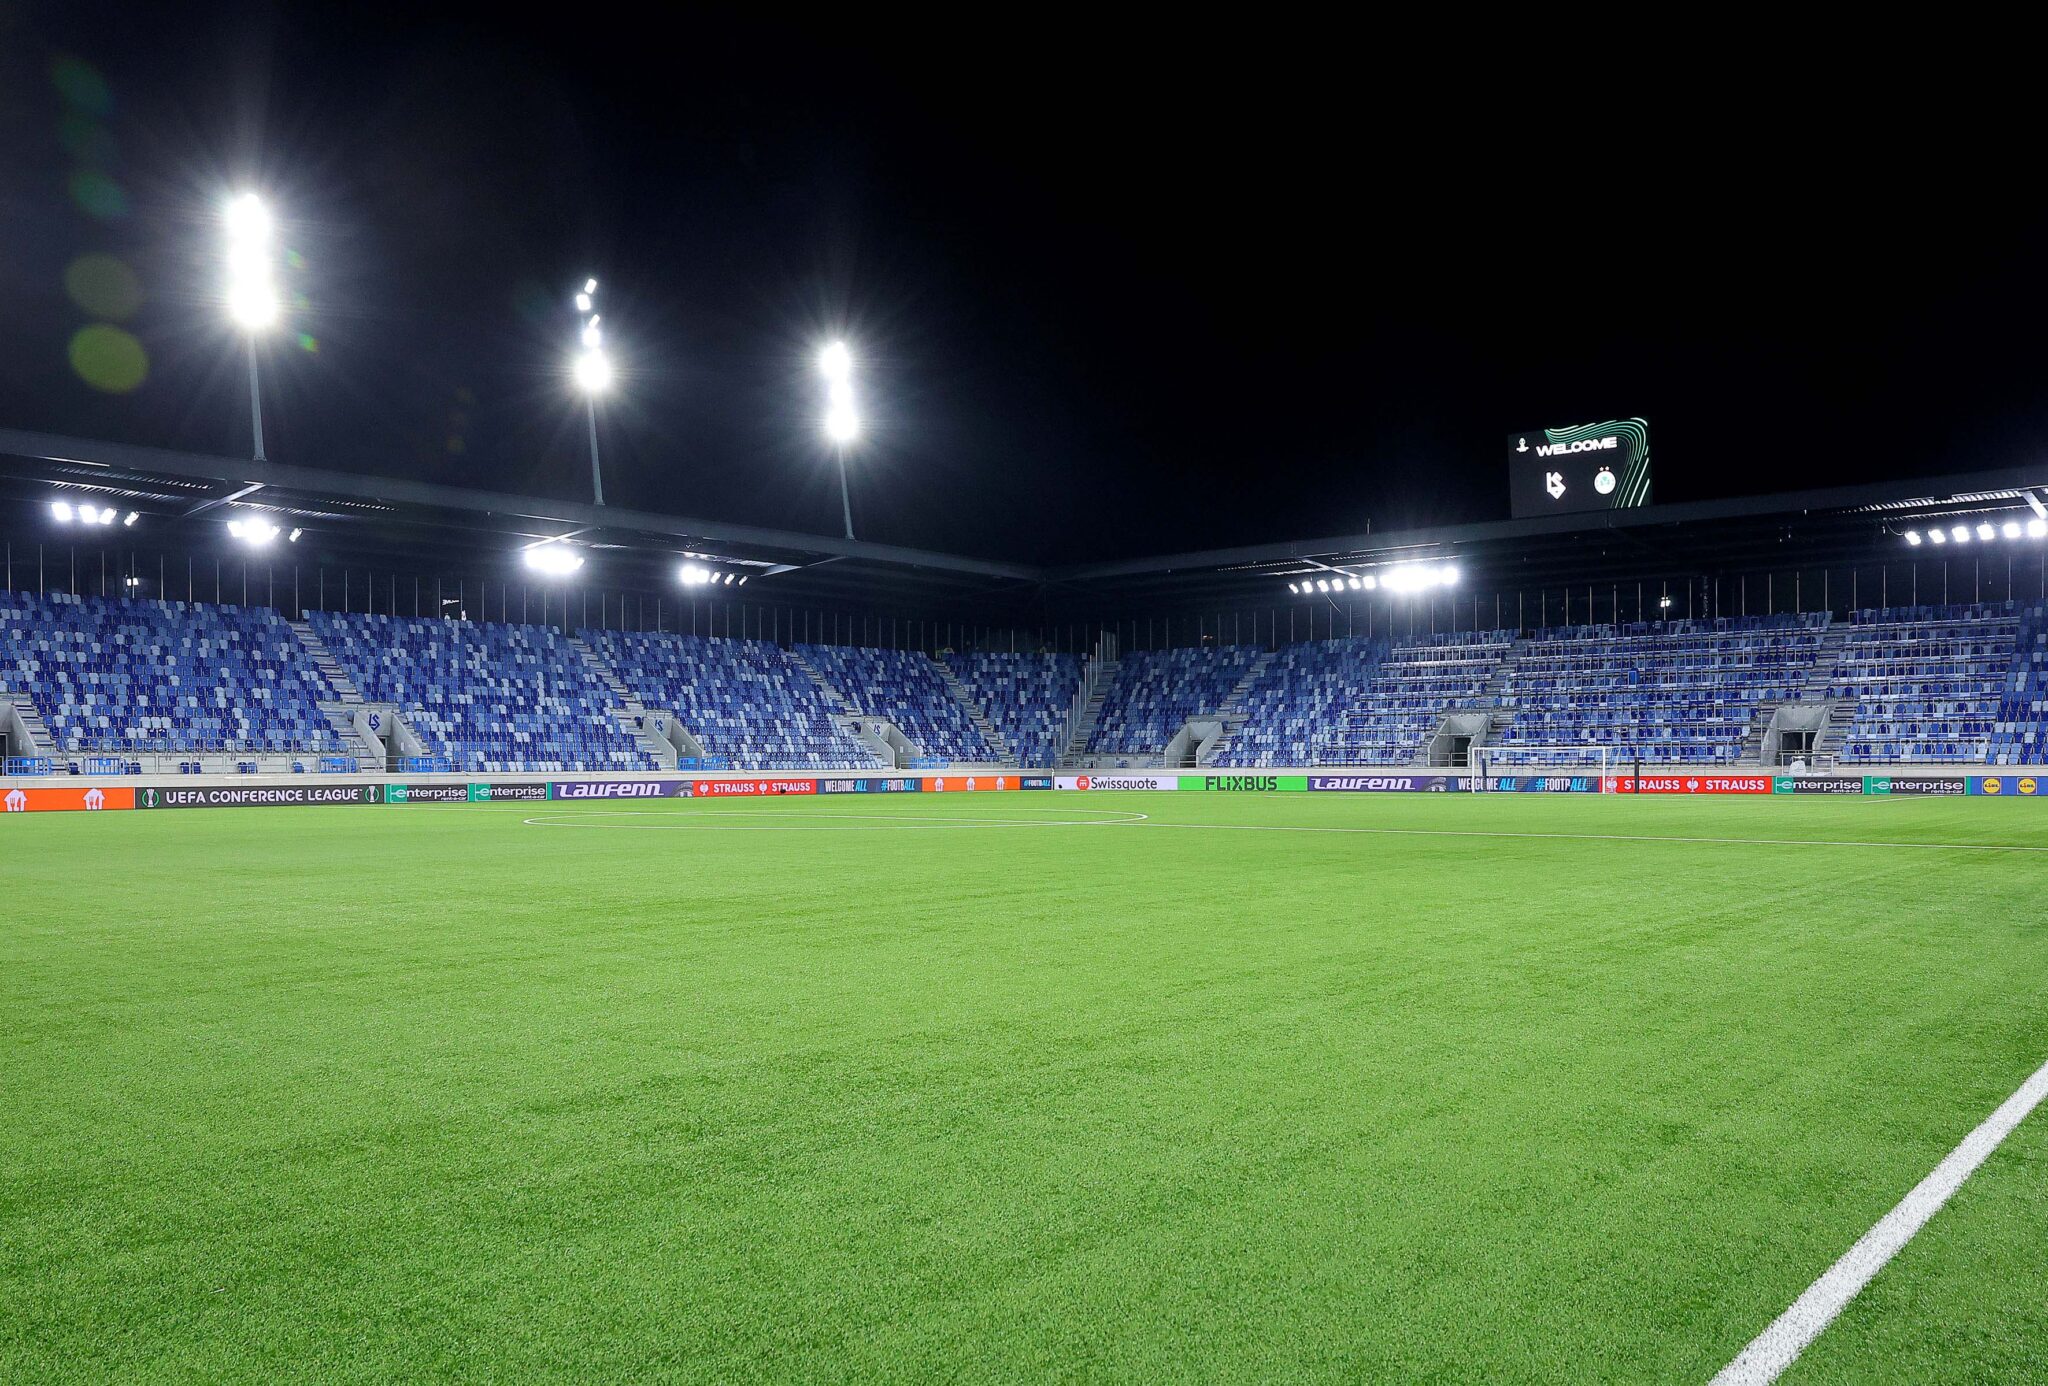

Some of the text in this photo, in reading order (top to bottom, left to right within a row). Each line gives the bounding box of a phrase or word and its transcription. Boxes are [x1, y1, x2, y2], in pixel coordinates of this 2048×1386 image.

[1536, 436, 1617, 457] WELCOME
[713, 782, 811, 793] STRAUSS STRAUSS
[824, 780, 868, 792] WELCOME ALL
[880, 779, 915, 791] #FOOTBALL
[1090, 776, 1158, 790] Swissquote
[1457, 777, 1516, 791] WECME ALL
[1705, 780, 1765, 790] STRAUSS
[1781, 779, 1861, 791] enterprise
[1877, 779, 1964, 792] enterprise
[166, 791, 206, 803] UEFA
[209, 789, 303, 803] CONFERENCE
[395, 787, 467, 799] enterprise
[479, 785, 546, 798] enterprise
